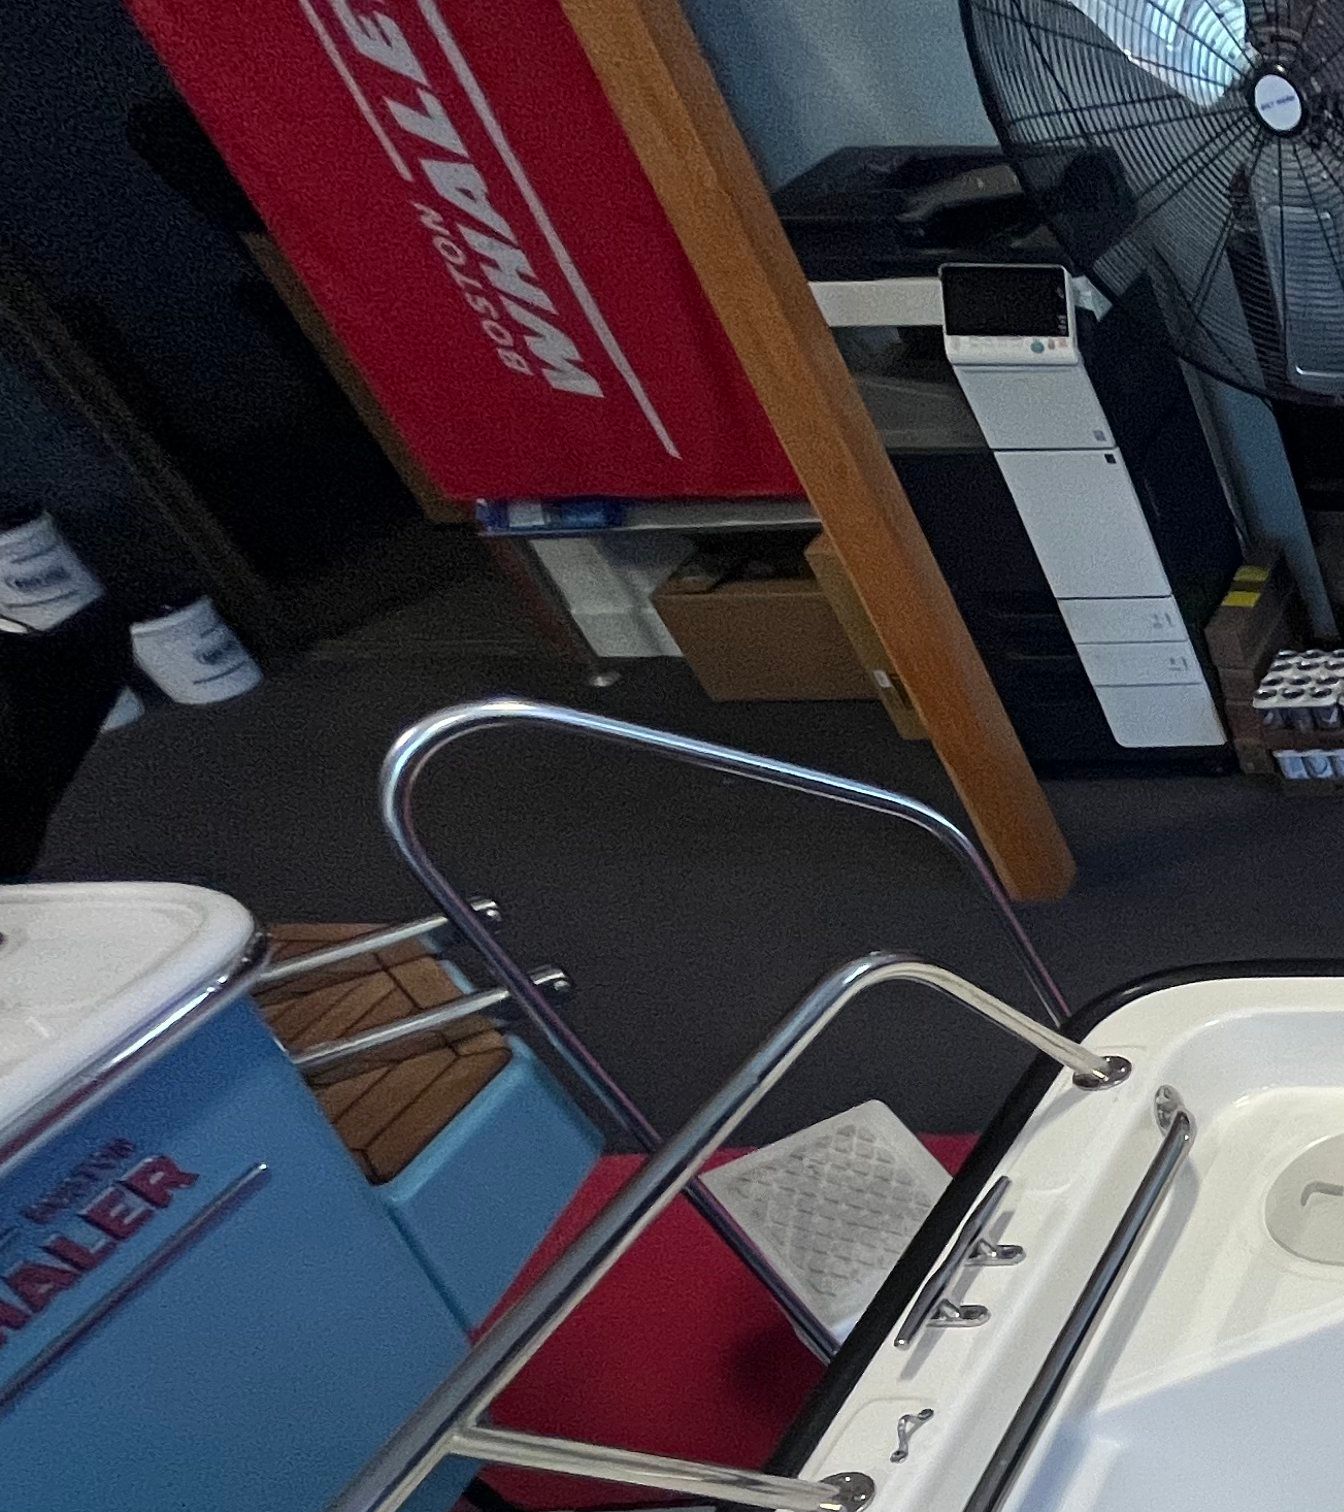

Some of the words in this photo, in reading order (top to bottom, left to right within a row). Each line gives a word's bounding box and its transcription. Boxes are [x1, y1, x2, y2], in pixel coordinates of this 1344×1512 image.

[331, 0, 604, 398] WHALE
[412, 202, 534, 376] BOSTON
[0, 1154, 200, 1346] ALER
